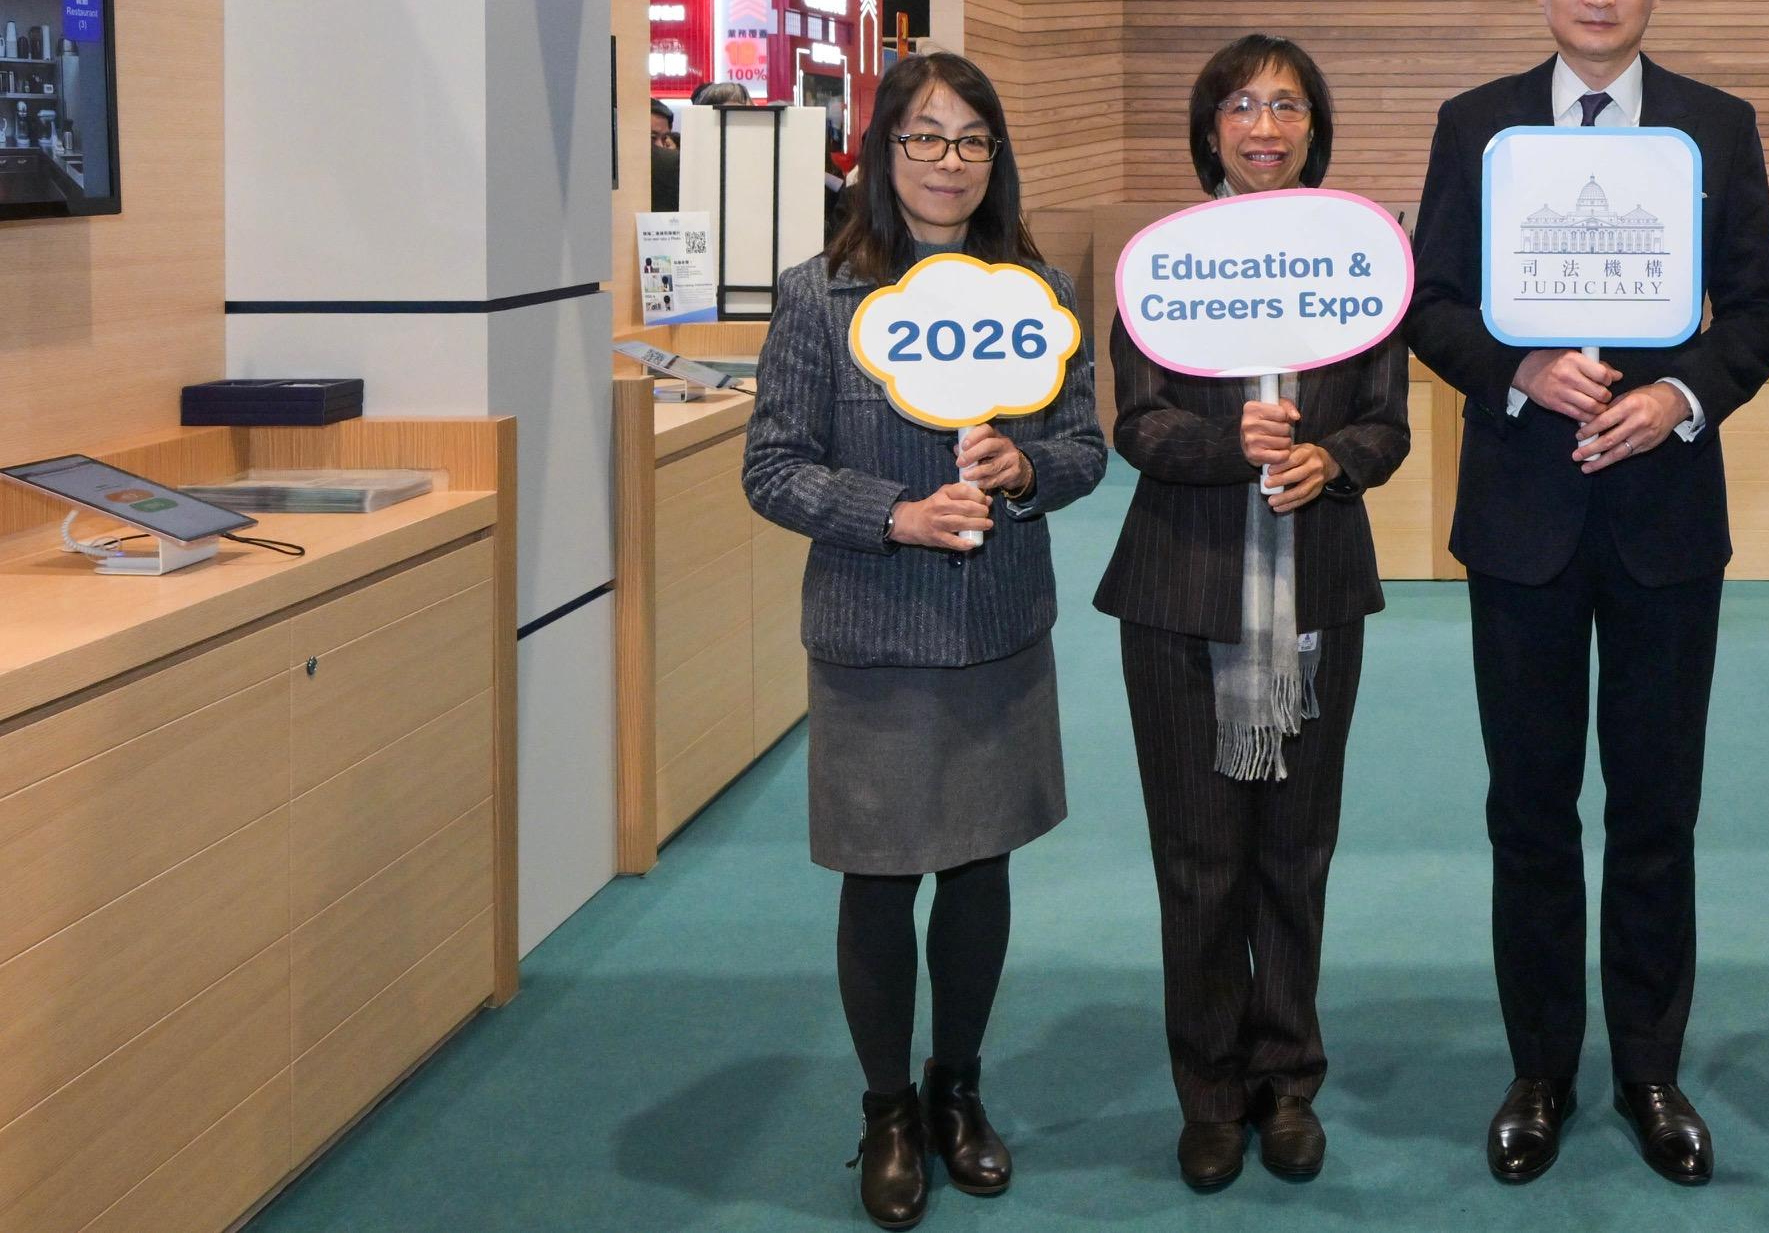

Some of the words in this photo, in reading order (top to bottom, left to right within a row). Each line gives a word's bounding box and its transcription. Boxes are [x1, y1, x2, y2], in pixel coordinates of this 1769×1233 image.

[728, 69, 767, 81] 100%
[1151, 251, 1335, 282] Education
[1348, 251, 1372, 278] &
[1521, 259, 1663, 278] 司法機構
[1521, 281, 1663, 295] JUDICIARY
[1140, 294, 1284, 322] Careers
[1298, 291, 1385, 325] Expo
[887, 318, 1048, 362] 2026
